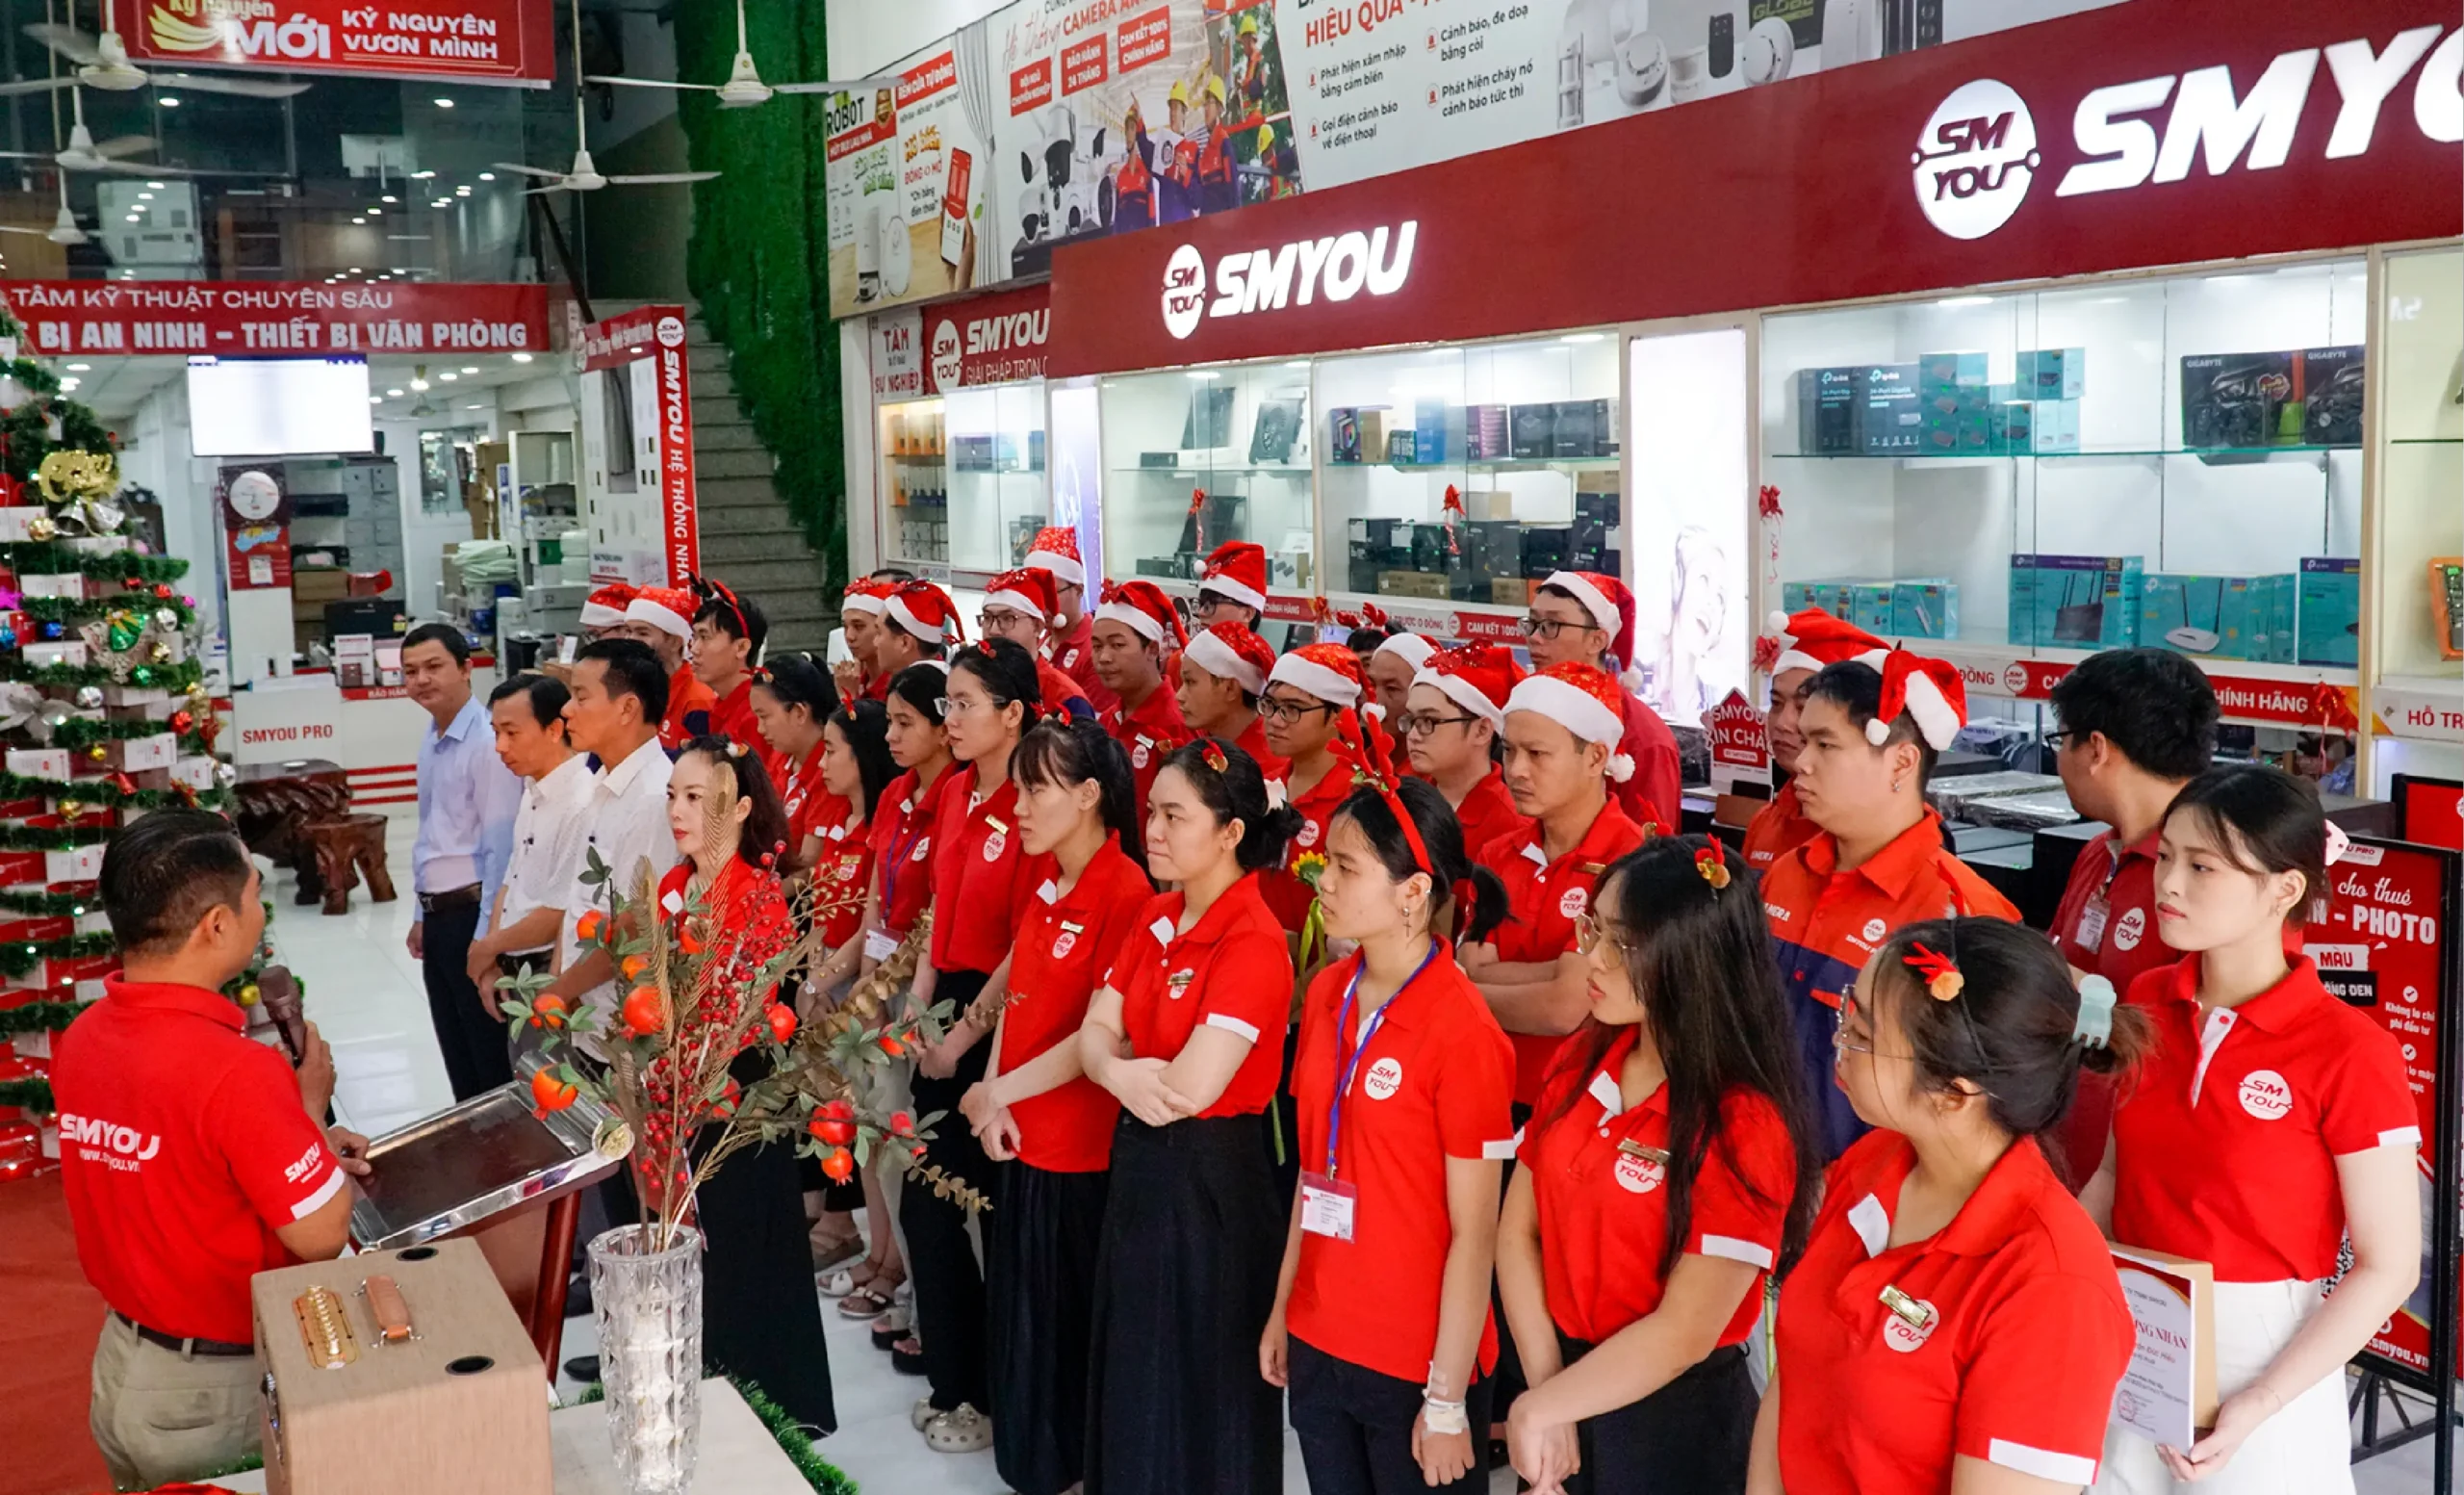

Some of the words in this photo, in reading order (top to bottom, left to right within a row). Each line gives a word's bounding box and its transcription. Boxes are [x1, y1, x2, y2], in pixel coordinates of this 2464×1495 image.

[388, 13, 497, 36] NGUYÊN
[1064, 0, 1116, 37] CAMERA
[1306, 8, 1352, 47] HIỆU
[1440, 22, 1467, 43] Cảnh
[342, 33, 421, 55] VƯƠN
[429, 36, 499, 59] MÌNH
[1321, 64, 1340, 82] Phát
[1342, 59, 1360, 78] hiện
[1362, 53, 1380, 68] xâm
[1442, 80, 1466, 99] Phát
[1468, 73, 1490, 93] hiện
[826, 96, 864, 137] ROBOT
[1337, 111, 1356, 129] điện
[1379, 100, 1399, 116] báo
[1334, 131, 1353, 148] điện
[1354, 125, 1377, 143] thoại
[1937, 111, 2015, 155] SM
[1934, 163, 2011, 202] YOU
[1171, 266, 1198, 288] SM
[1209, 219, 1418, 318] SMYOU
[12, 286, 75, 307] TÂM
[126, 285, 218, 312] THUẬT
[222, 286, 335, 309] CHUYÊN
[341, 288, 393, 309] SÂU
[1168, 293, 1200, 315] YOU
[38, 321, 72, 351] BỊ
[81, 321, 124, 348] AN
[133, 321, 207, 348] NINH
[241, 315, 321, 348] THIẾT
[329, 322, 360, 351] BỊ
[366, 318, 424, 348] VĂN
[432, 318, 527, 348] PHÒNG
[884, 322, 911, 353] TÂM
[965, 308, 1051, 355] SMYOU
[937, 339, 956, 357] SM
[2307, 350, 2347, 360] GIGABYTE
[937, 364, 958, 380] YOU
[663, 348, 685, 444] SMYOU
[666, 450, 688, 474] HỆ
[672, 479, 692, 539] THỐNG
[1467, 621, 1485, 633] CAM
[2215, 688, 2254, 709] HÍNH
[2258, 689, 2309, 713] HÃNG
[1713, 705, 1765, 726] SMYOU
[2407, 705, 2435, 727] HỖ
[243, 726, 297, 744] SMYOU
[302, 724, 333, 740] PRO
[2338, 871, 2369, 898] cho
[2374, 876, 2413, 906] thuê
[2117, 927, 2140, 941] YOU
[2123, 915, 2142, 930] SM
[2351, 904, 2437, 945] PHOTO
[2347, 982, 2374, 997] ĐEN
[2385, 1001, 2411, 1018] Không
[2412, 1007, 2422, 1018] lo
[1369, 1076, 1393, 1091] YOU
[1377, 1066, 1398, 1080] SM
[2253, 1080, 2284, 1096] SM
[2244, 1093, 2282, 1109] YOU
[59, 1113, 161, 1161] SMYOU
[284, 1141, 321, 1183] SMYOU
[1619, 1165, 1652, 1183] YOU
[1889, 1322, 1924, 1342] YOU
